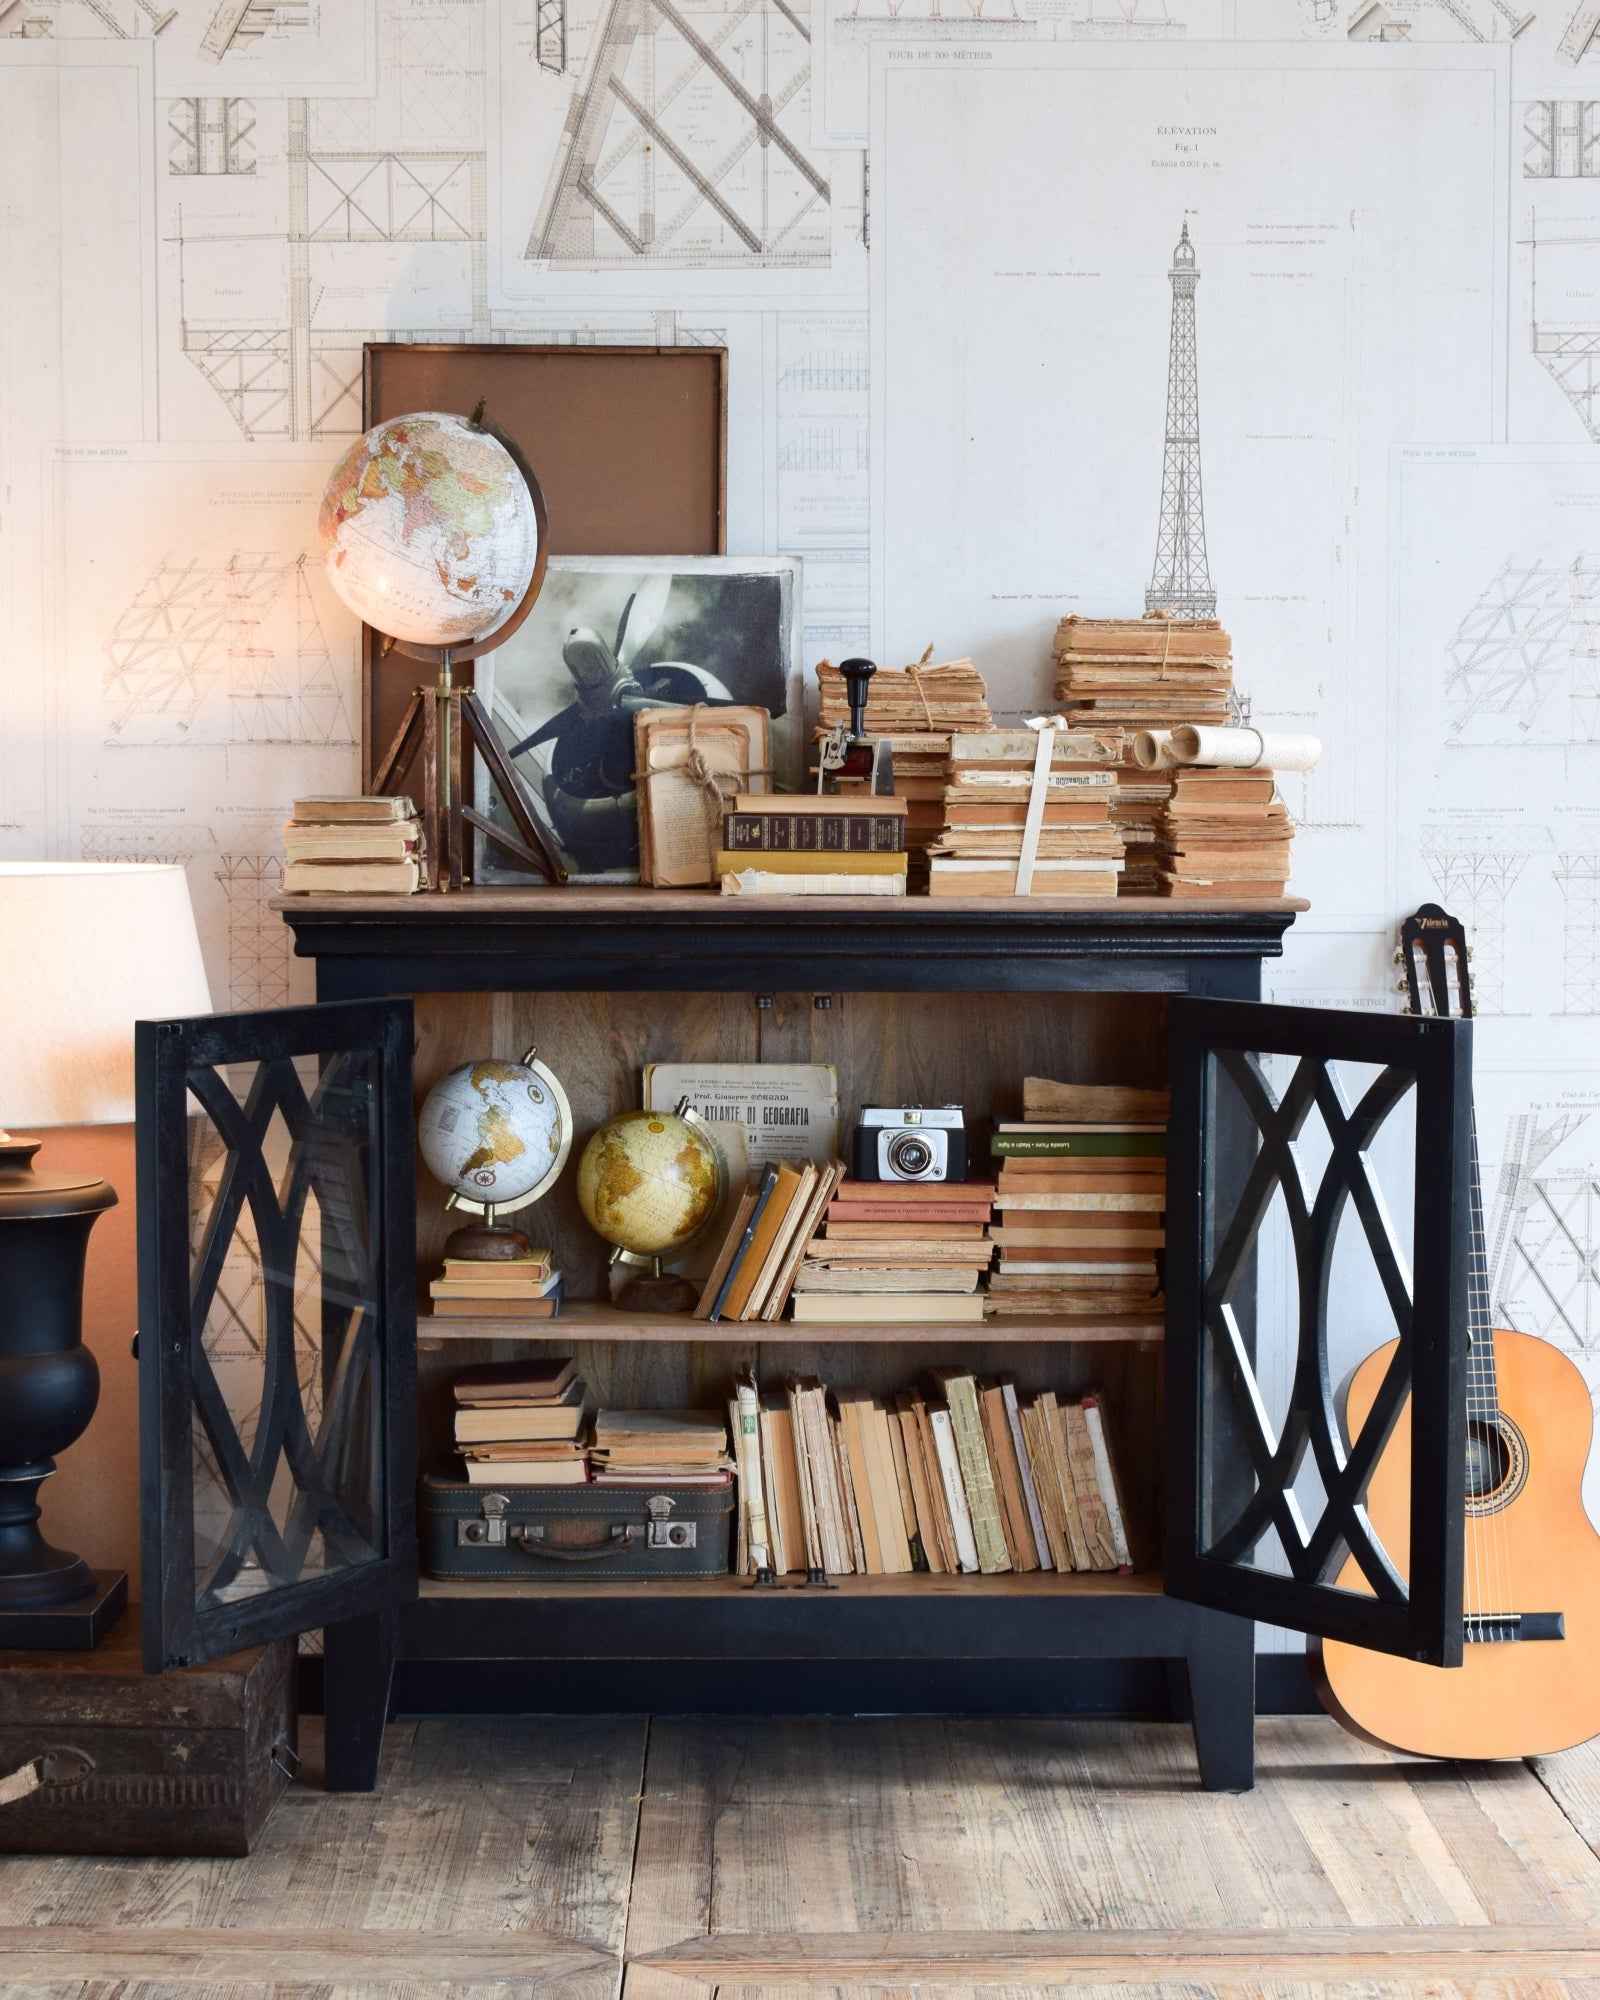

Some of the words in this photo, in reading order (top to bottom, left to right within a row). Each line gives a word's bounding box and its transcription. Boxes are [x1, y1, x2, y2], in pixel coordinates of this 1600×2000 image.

[888, 51, 913, 59] TOUR
[918, 51, 931, 59] DE
[935, 51, 950, 59] 300
[1157, 125, 1217, 135] ÉLÉVATION
[1175, 143, 1191, 153] Fig.
[1414, 917, 1449, 930] Valencia
[694, 1092, 712, 1100] Prof.
[747, 1106, 756, 1125] DI
[763, 1106, 809, 1126] GEOGRAFIA
